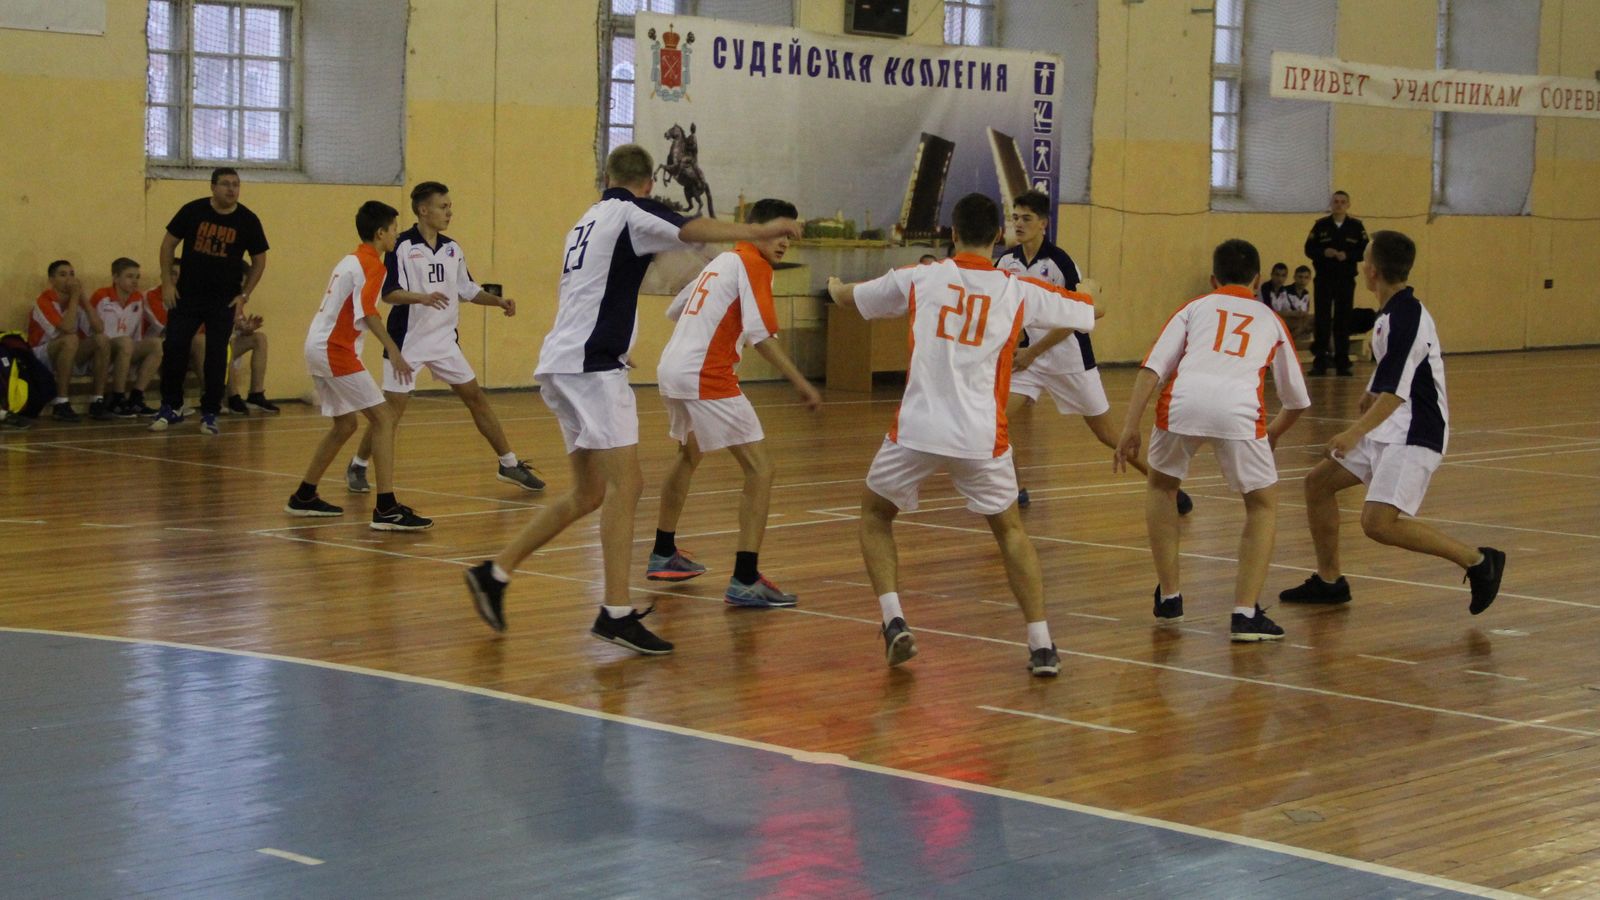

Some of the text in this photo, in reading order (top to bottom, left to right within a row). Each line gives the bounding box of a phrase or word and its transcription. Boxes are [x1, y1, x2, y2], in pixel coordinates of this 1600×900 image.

[713, 36, 1007, 92] СУДЕЙСКАЯ КОЛЛЕГИЯ
[1283, 66, 1370, 96] ПРИВЕТ
[1392, 78, 1523, 107] УЧАСТНИКАМ
[197, 221, 236, 243] HAND
[563, 220, 596, 274] 23
[428, 263, 445, 283] 20
[684, 272, 719, 315] 15
[936, 284, 991, 346] 20
[1213, 308, 1254, 358] 13
